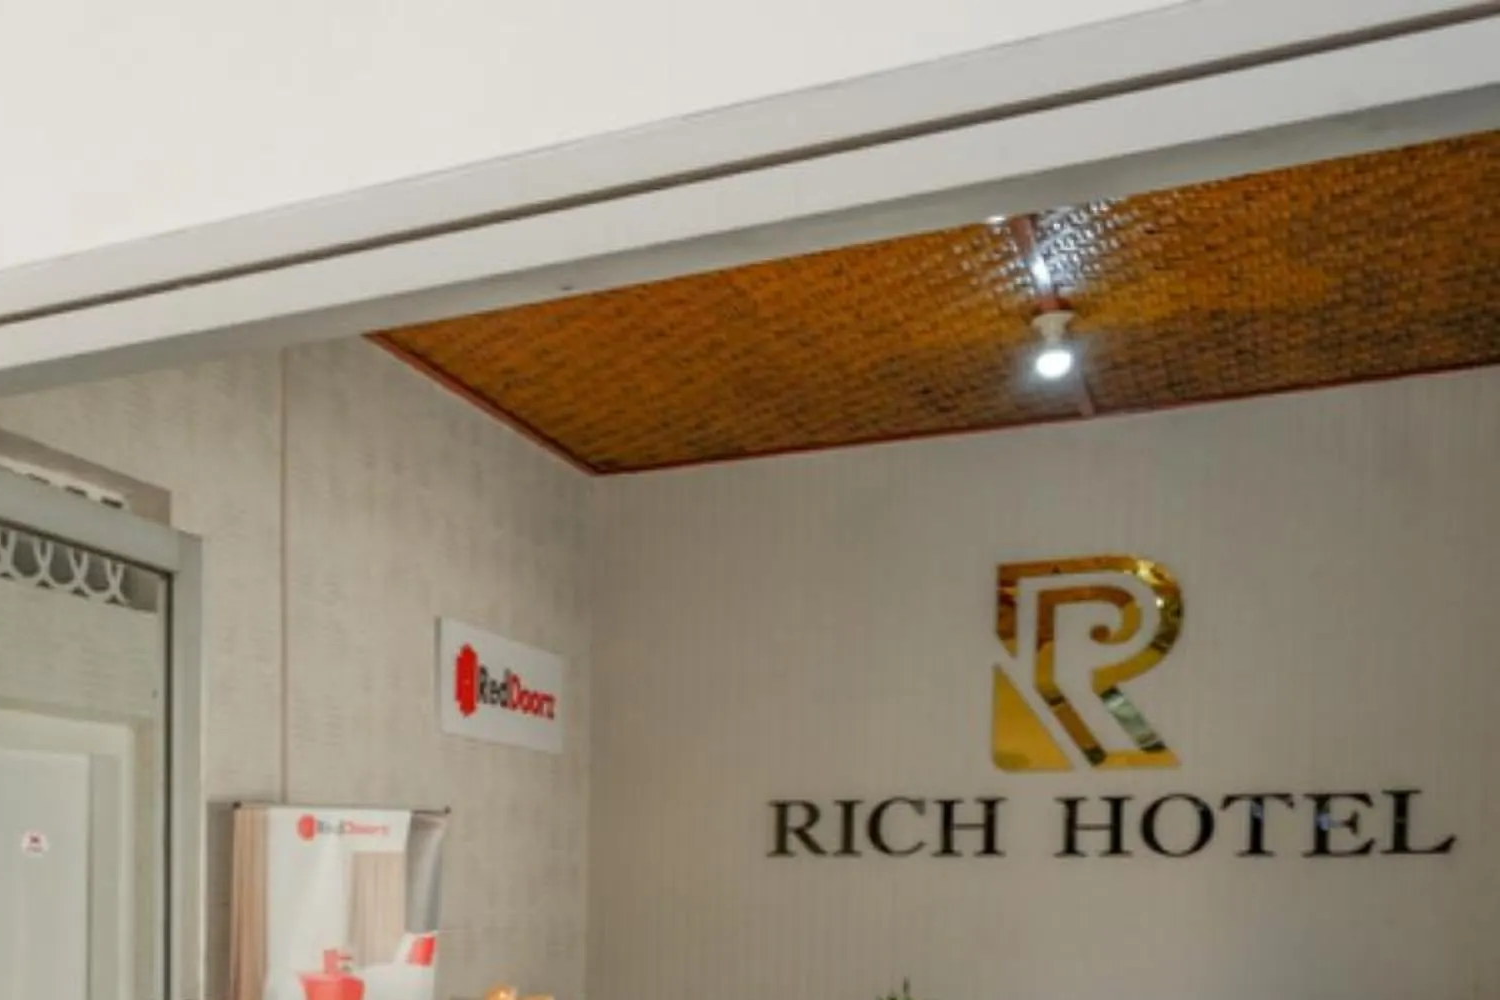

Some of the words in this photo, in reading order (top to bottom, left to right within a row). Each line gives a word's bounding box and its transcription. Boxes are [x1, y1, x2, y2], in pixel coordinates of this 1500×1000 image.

[478, 664, 556, 720] RedDoorz
[765, 796, 1007, 859] RICH
[1052, 789, 1457, 859] HOTEL
